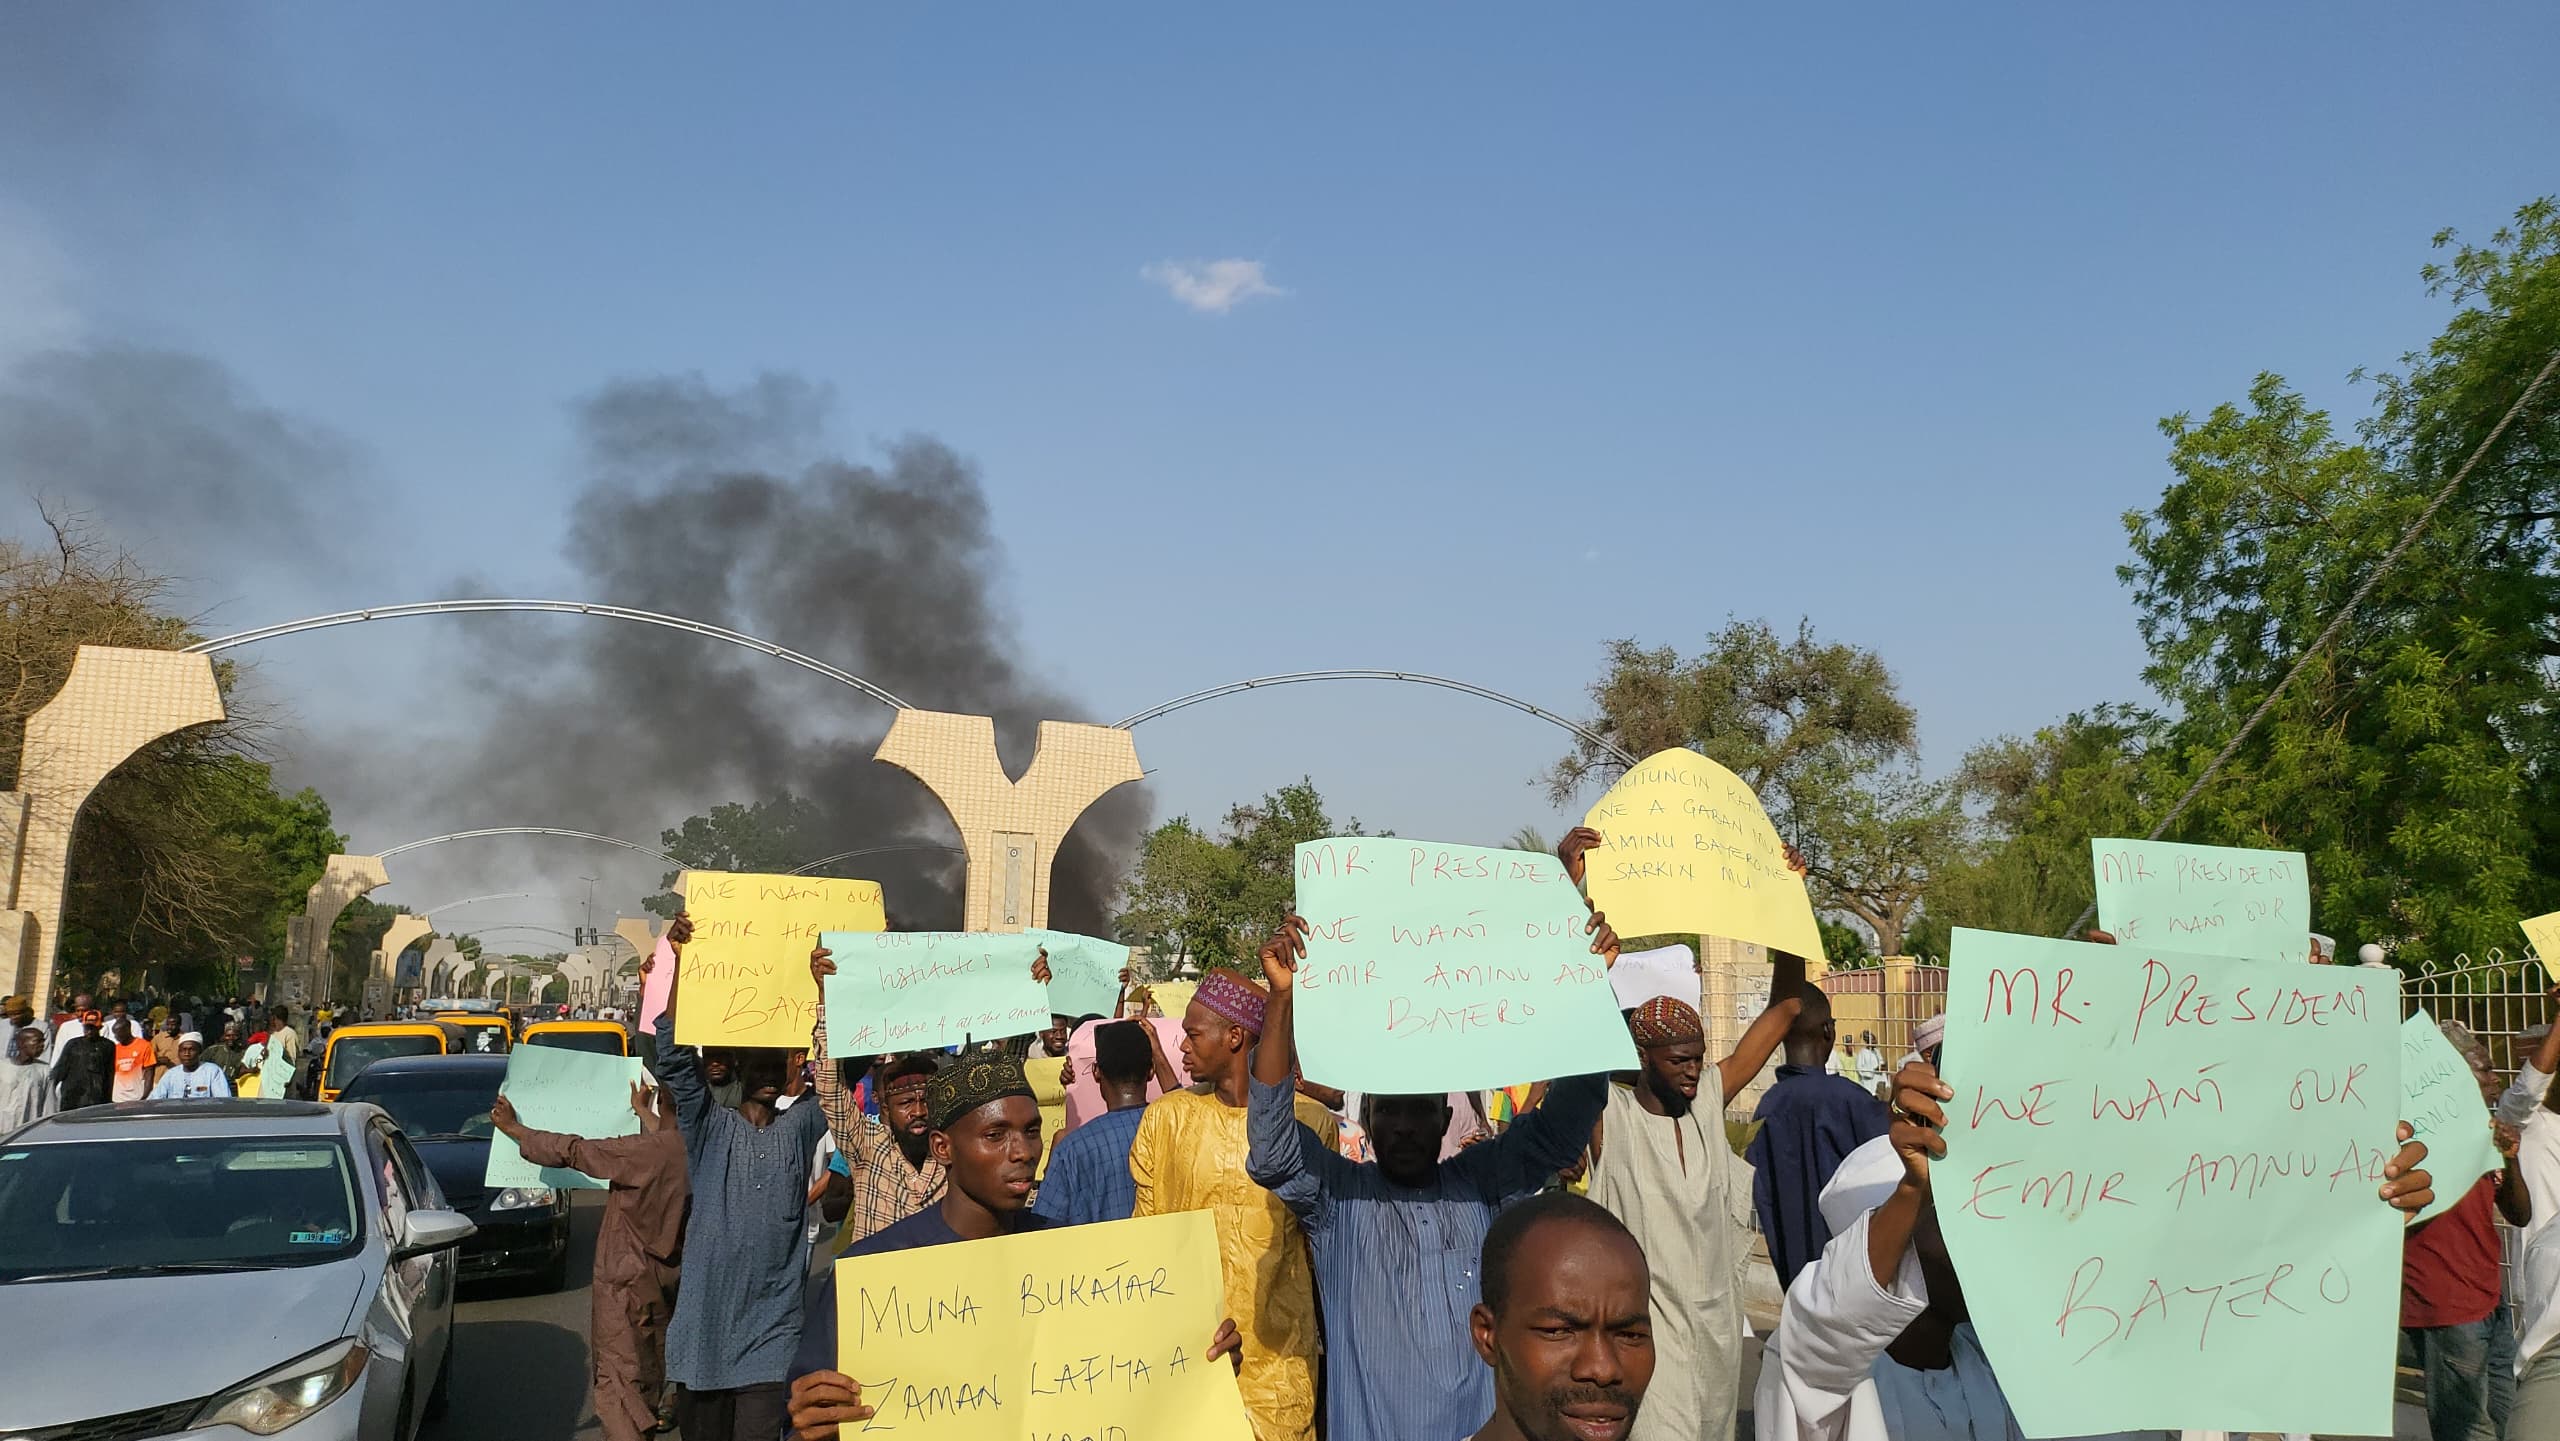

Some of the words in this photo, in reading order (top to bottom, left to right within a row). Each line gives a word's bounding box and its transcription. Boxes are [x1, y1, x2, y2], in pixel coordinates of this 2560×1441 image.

[1600, 802, 1628, 822] NE
[1648, 799, 1666, 817] A
[1597, 829, 1675, 857] AMINU
[1301, 844, 1375, 881] MR.
[1410, 846, 1570, 887] PRESIDEN
[1608, 860, 1695, 882] SARKIN
[1721, 865, 1752, 890] MU
[2102, 850, 2157, 886] MR.
[2175, 854, 2296, 894] PRESIDENT
[690, 879, 737, 905] WE
[761, 878, 831, 902] WANT
[847, 887, 884, 907] OUR
[691, 917, 760, 940] EMIR
[1308, 915, 1360, 943] WE
[1392, 909, 1489, 946] WANT
[1526, 914, 1591, 940] OUR
[2113, 917, 2145, 946] WE
[2169, 899, 2226, 934] WANT
[2245, 896, 2289, 925] OUR
[681, 953, 774, 984] AMINU
[1300, 960, 1382, 990] EMIR
[1424, 961, 1531, 990] AMINU
[722, 986, 819, 1034] BAYE
[1983, 967, 2092, 1028] MR.
[2132, 958, 2369, 1045] PRESIDENT
[1970, 1078, 2072, 1130] WE
[2092, 1061, 2227, 1122] WANT
[2289, 1063, 2369, 1111] OUR
[1957, 1158, 2138, 1219] EMIR
[2330, 1138, 2390, 1193] AD
[860, 1283, 983, 1351] MUNA
[1020, 1260, 1175, 1318] BUKATAR
[2056, 1256, 2351, 1366] BAYERO
[859, 1374, 1002, 1433] ZAMAN
[1169, 1346, 1190, 1378] A
